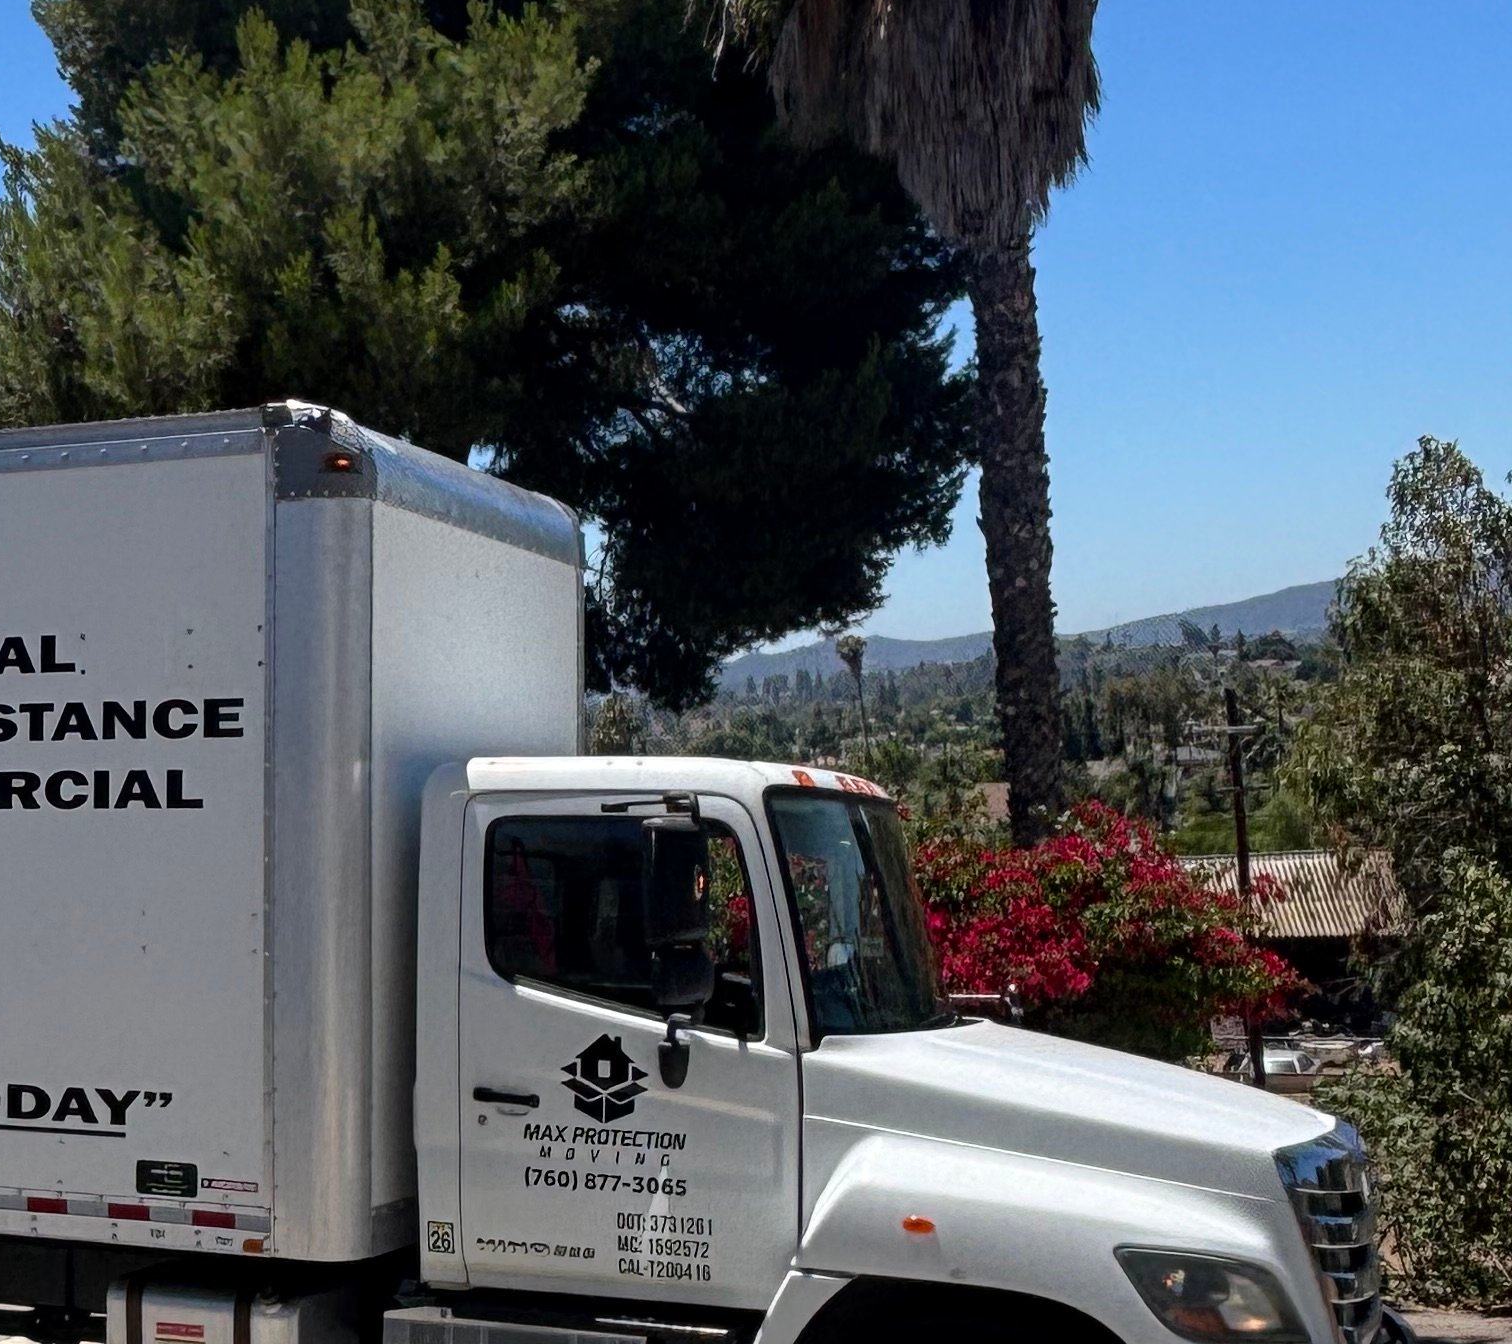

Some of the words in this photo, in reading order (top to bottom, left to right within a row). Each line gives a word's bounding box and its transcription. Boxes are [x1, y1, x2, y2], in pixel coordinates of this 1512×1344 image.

[523, 1123, 569, 1143] MAX
[572, 1126, 687, 1151] PROTECTION
[539, 1145, 671, 1167] MOVING
[524, 1166, 578, 1192] (760)
[584, 1172, 688, 1197] 877-3065
[430, 1230, 452, 1253] 26
